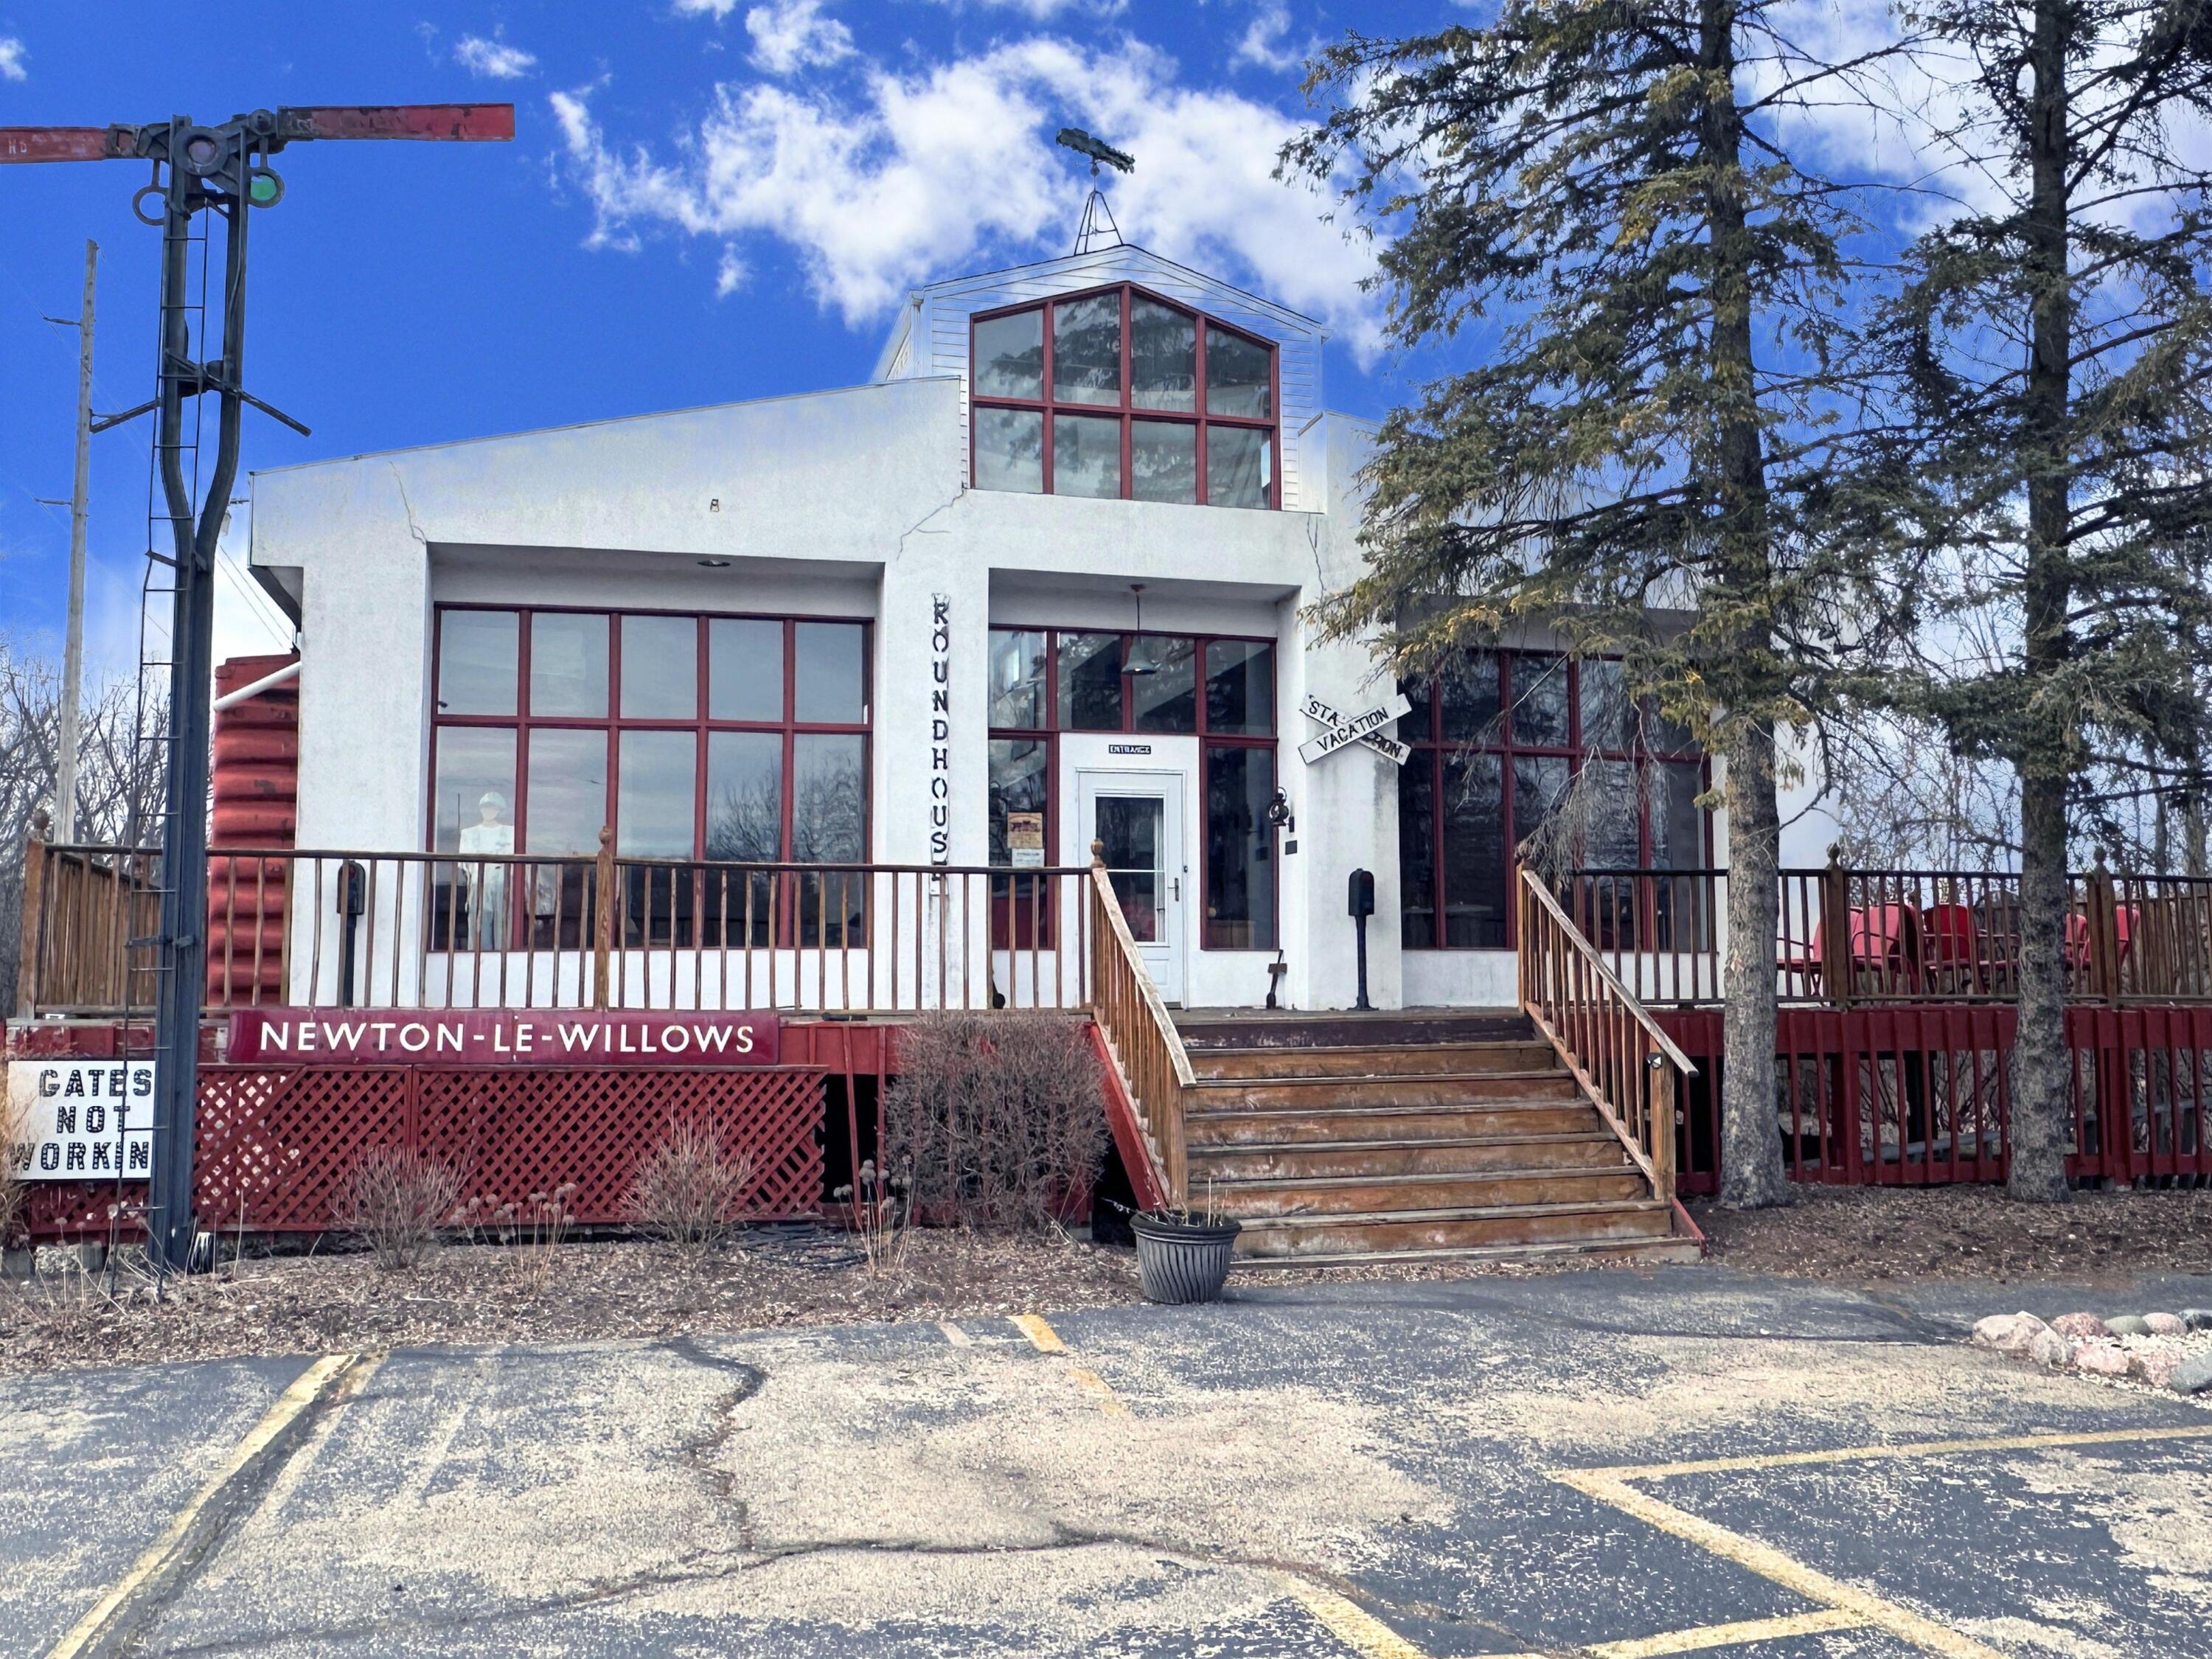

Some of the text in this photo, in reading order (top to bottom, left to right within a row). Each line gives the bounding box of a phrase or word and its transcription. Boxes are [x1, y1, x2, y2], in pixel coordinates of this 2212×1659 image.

[1316, 706, 1389, 751] VACATION
[39, 1069, 152, 1097] GATES
[57, 1105, 131, 1133] NOT
[11, 1141, 149, 1171] WORKIN
